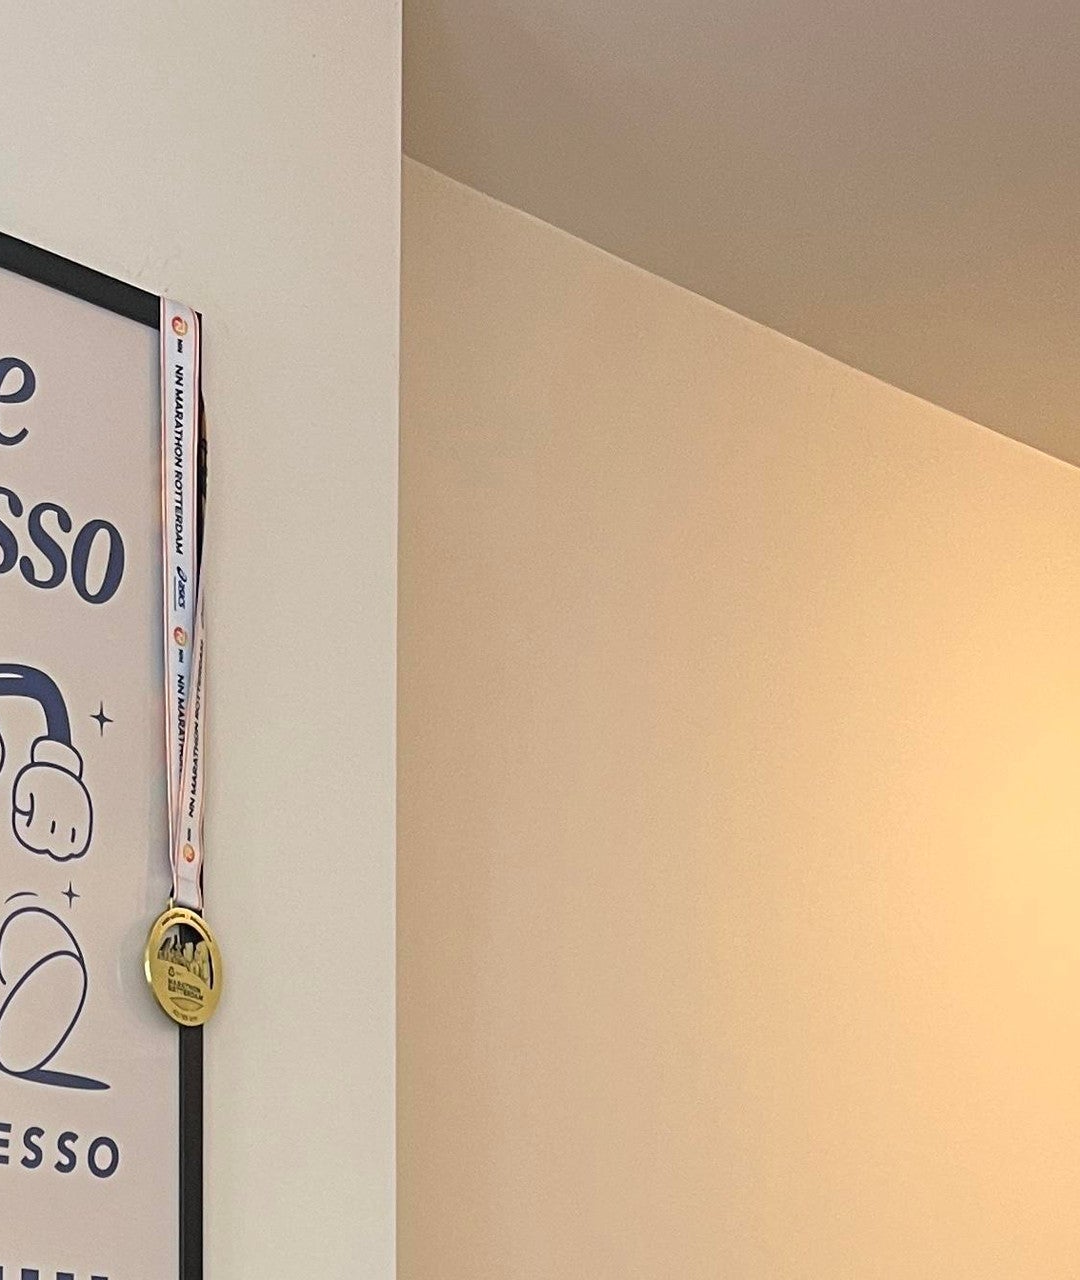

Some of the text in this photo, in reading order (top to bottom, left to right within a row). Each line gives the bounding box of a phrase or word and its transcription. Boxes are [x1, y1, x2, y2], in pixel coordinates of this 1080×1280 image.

[174, 364, 184, 555] NN MARATHON ROTTERDAM
[176, 674, 186, 697] NN
[189, 723, 199, 795] MARATHON
